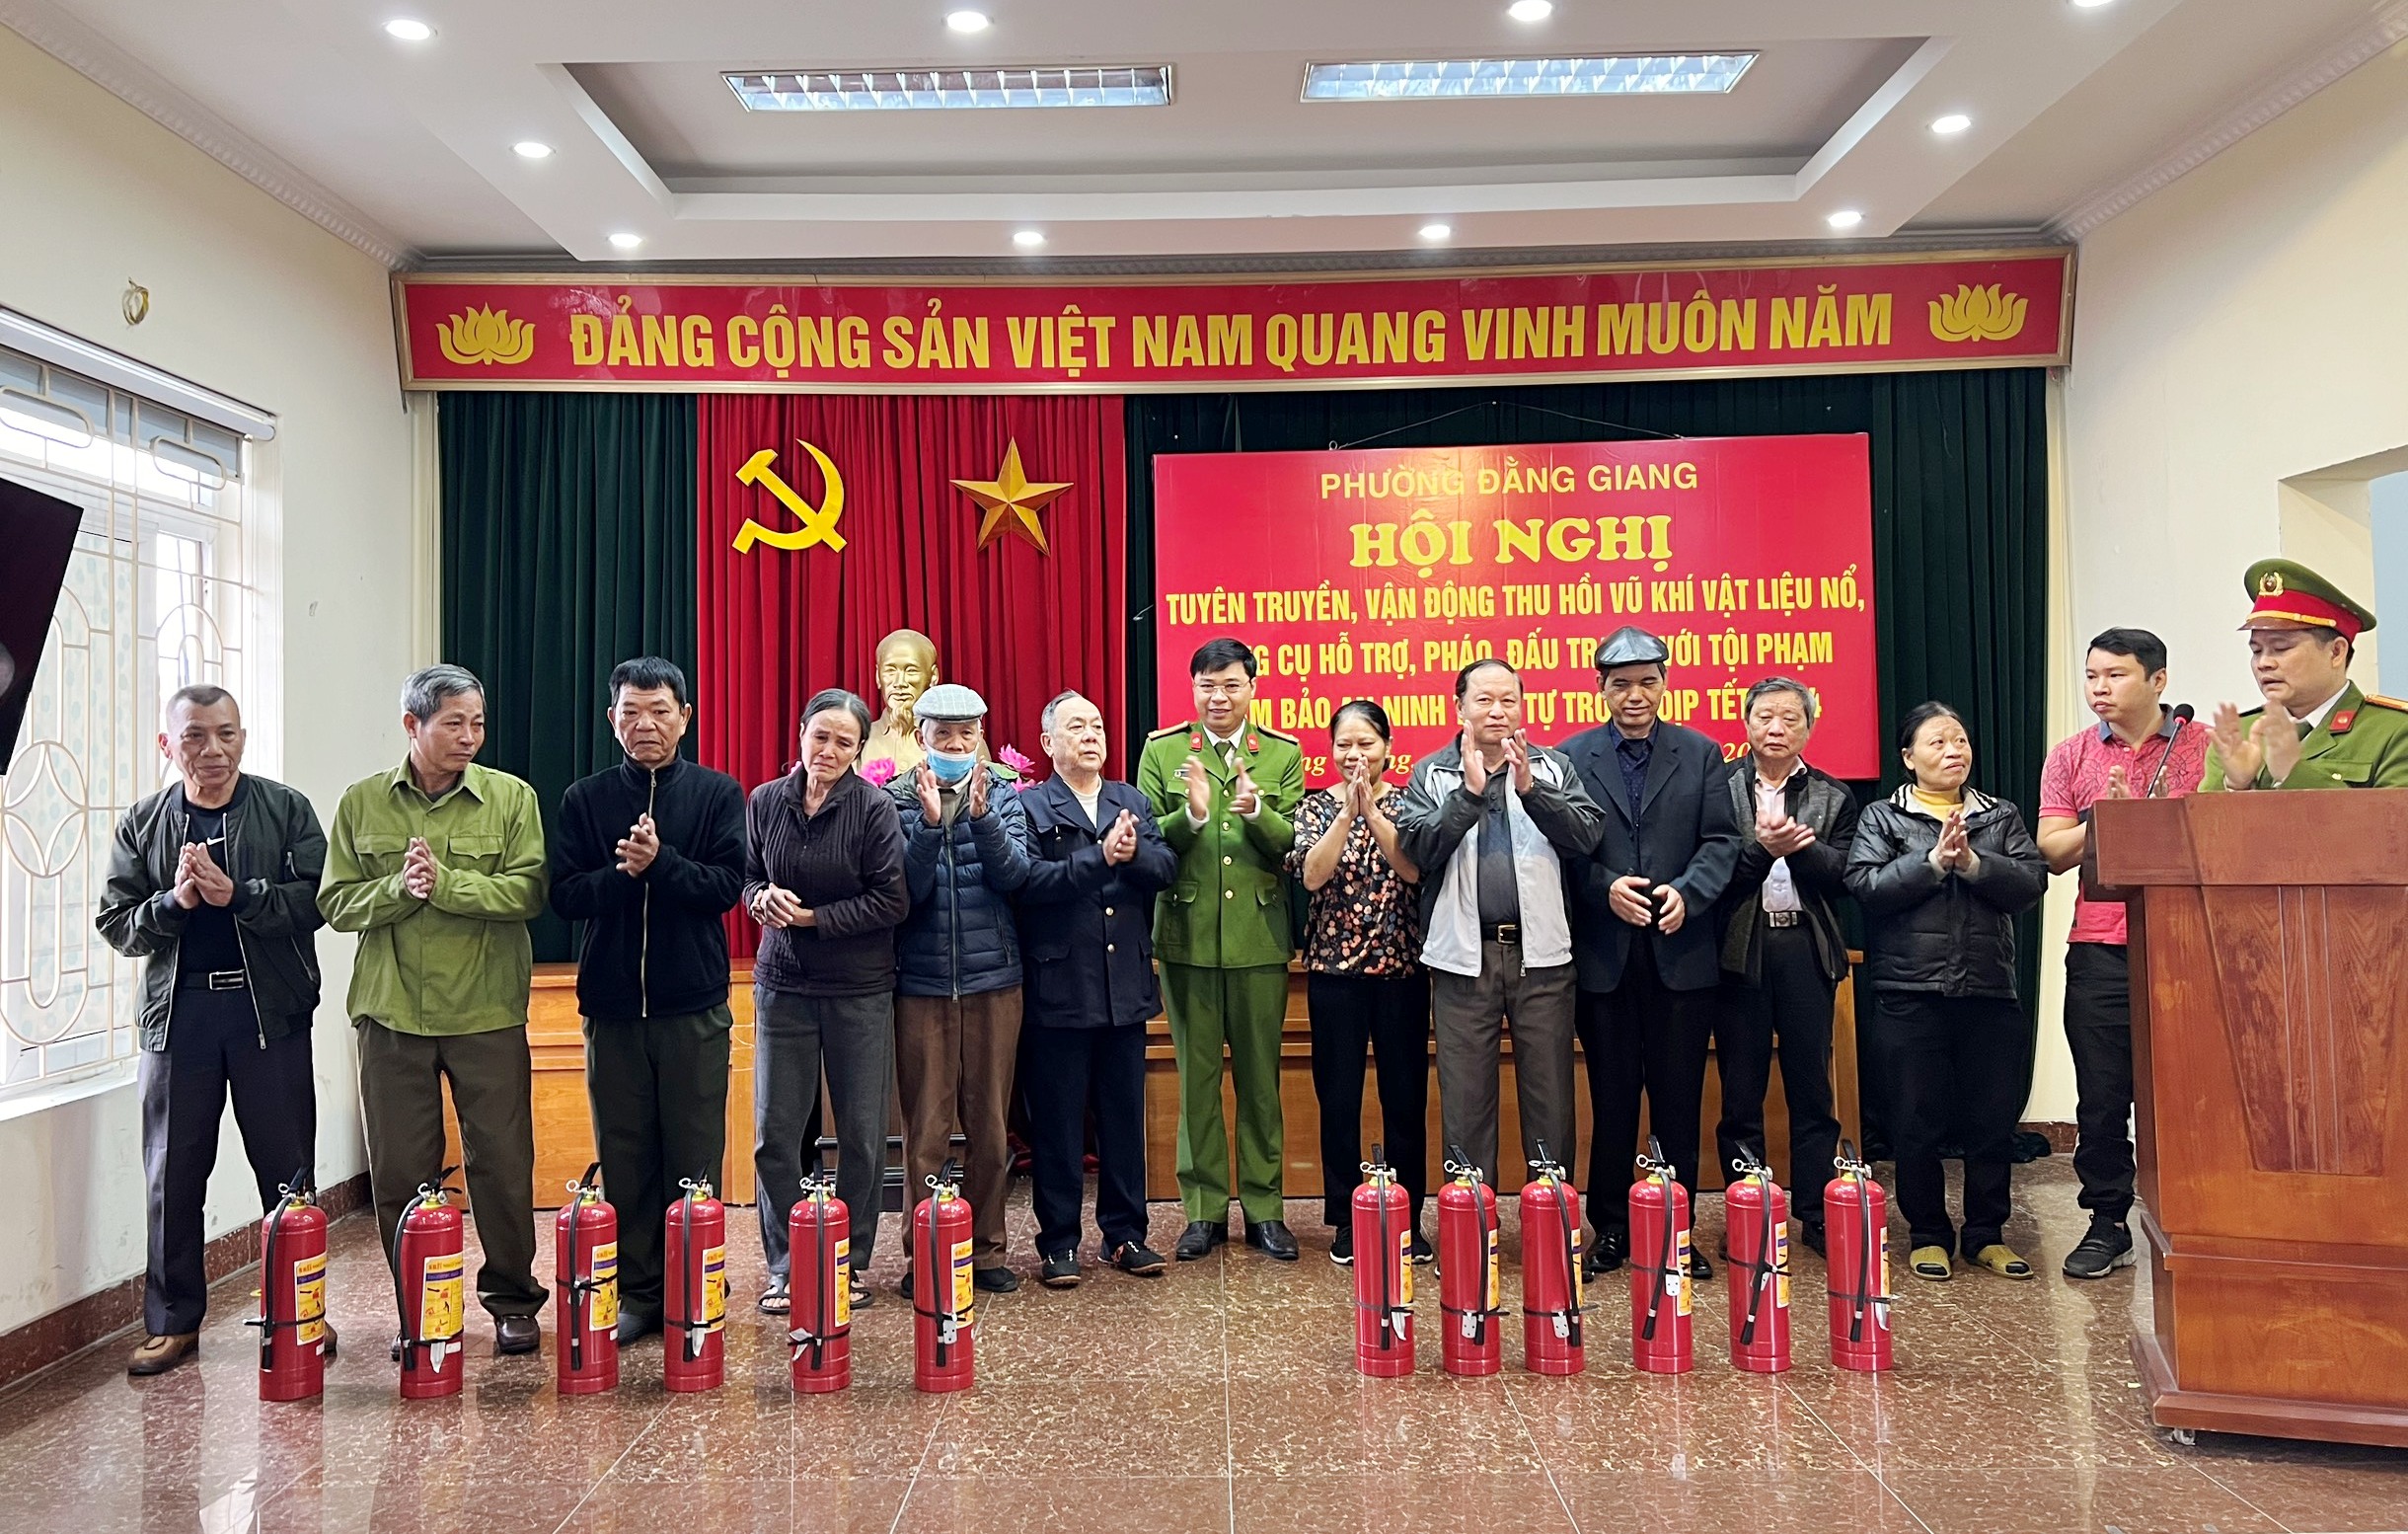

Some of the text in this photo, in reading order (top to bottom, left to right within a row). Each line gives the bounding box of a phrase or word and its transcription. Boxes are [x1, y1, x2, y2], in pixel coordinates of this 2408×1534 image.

[569, 284, 1893, 379] ĐẢNG CỘNG SẢN VIỆT NAM QUANG VINH MUÔN NĂM
[1320, 455, 1698, 499] PHƯỜNG ĐẰNG GIANG
[1349, 507, 1674, 578] HỘI NGHỊ
[1166, 563, 1865, 627] TUYÊN TRUYỀN, VẬN ĐỘNG THU HỒI VŨ KHÍ VẬT LIỆU NỔ,
[1277, 644, 1312, 683] CỤ
[1318, 632, 1353, 674] HỖ
[1359, 638, 1417, 680] TRỢ,
[1506, 627, 1559, 670] ĐẤU
[1707, 627, 1750, 673] TỘI
[1756, 632, 1834, 671] PHẠM
[1280, 686, 1331, 729] BẢO
[1382, 694, 1447, 727] NINH
[1523, 688, 1558, 731] TỰ
[1562, 691, 1612, 724] TRO
